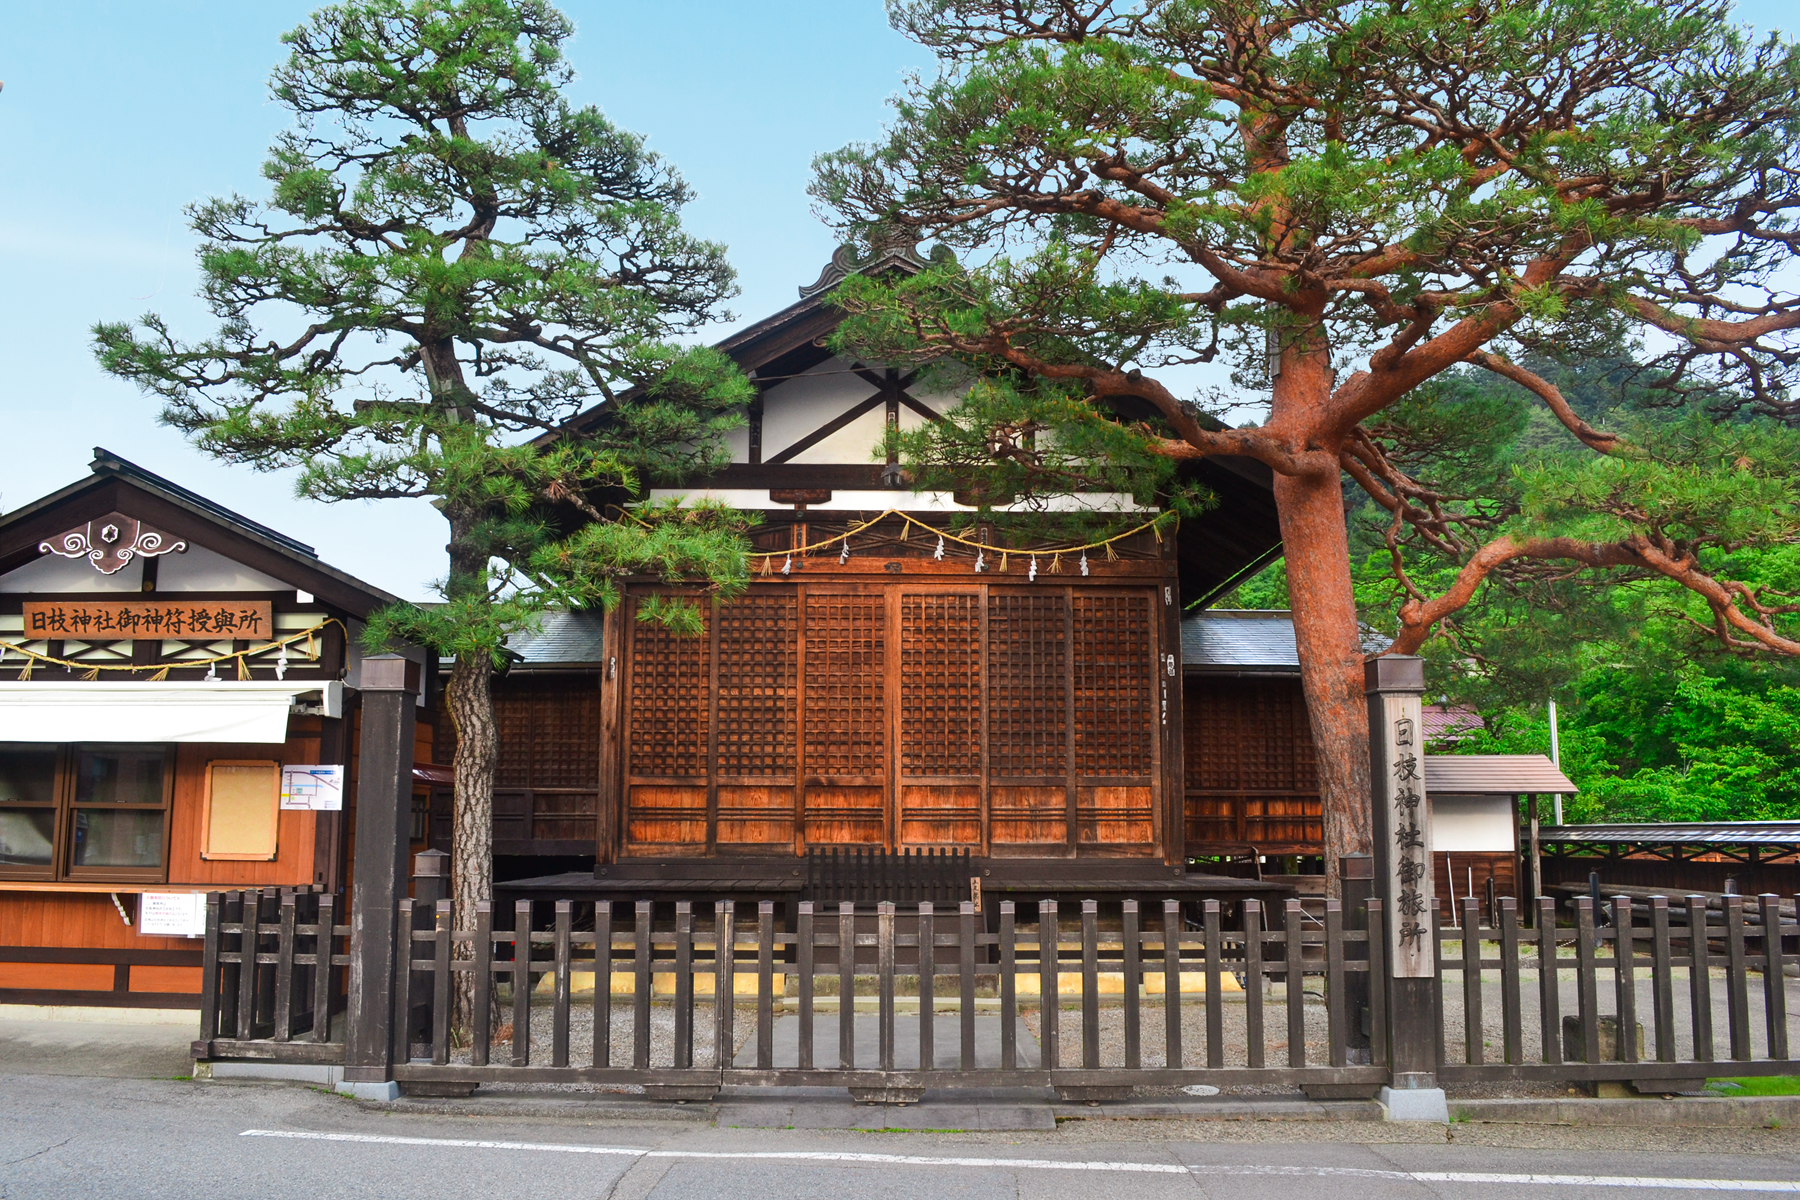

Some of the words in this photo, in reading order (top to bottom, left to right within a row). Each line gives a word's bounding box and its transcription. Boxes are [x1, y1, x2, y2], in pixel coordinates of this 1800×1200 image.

[31, 607, 262, 634] 日枝神社御神符授與所
[1393, 718, 1428, 952] 日枝神社御旅所
